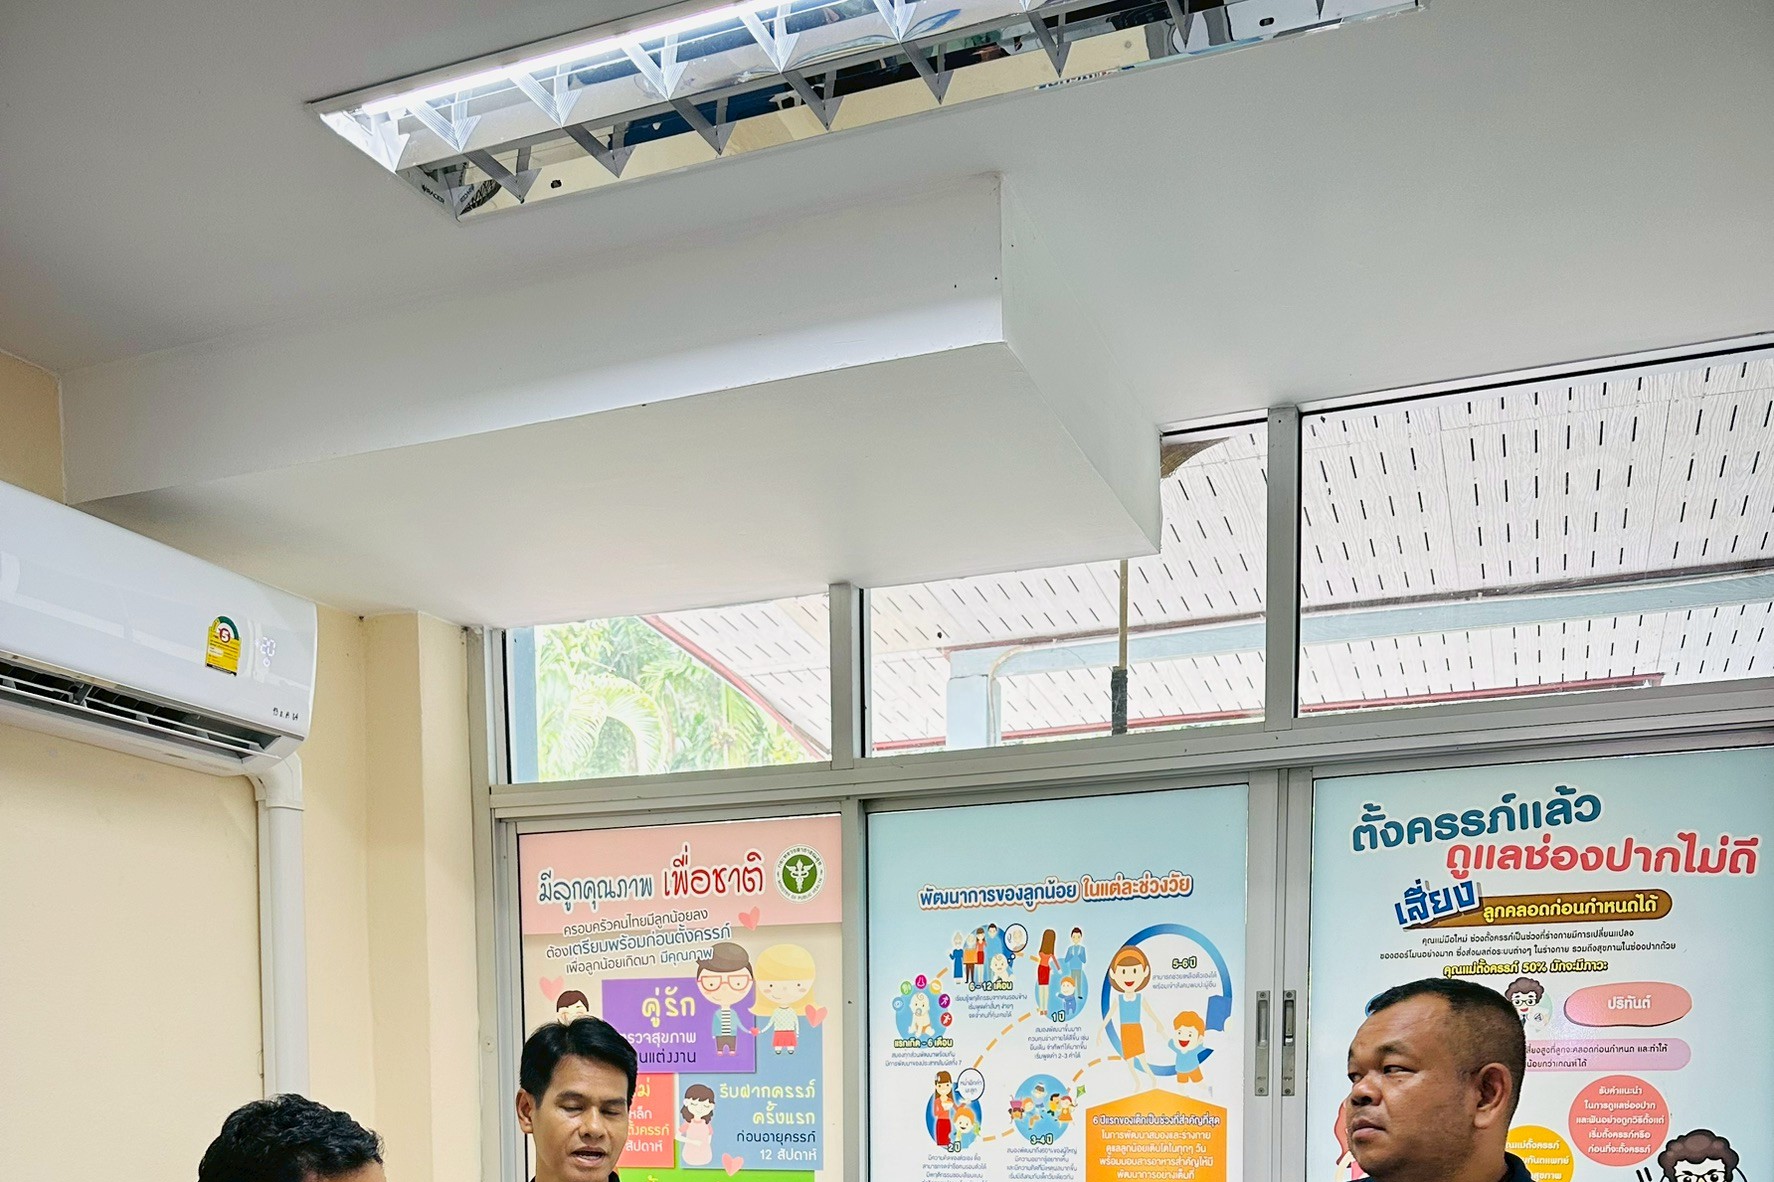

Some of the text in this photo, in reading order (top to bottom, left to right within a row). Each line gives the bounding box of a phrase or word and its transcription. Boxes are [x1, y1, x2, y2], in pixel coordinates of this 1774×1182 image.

[1351, 785, 1603, 852] ตั้งครรภ์แล้ว
[1446, 833, 1759, 880] ดูแลช่องปากไม่ดี
[539, 842, 764, 911] มีลูกคุณภาพ เพื่อชาติ
[919, 871, 1192, 908] พัฒนาการของลูกน้อย ในแต่ละช่วงวัย
[1395, 878, 1481, 928] เสี่ยง
[1484, 889, 1658, 924] ลูกคลอดก่อนกำหนดได้
[564, 909, 708, 936] ครอบครัวคนไทยมีลูกน้อยลง
[547, 922, 731, 959] ต้องเตรียมพร้อมก่อนตั้งครรภ์
[566, 948, 713, 975] เพื่อลูกน้อยเกิดมา มีคุณภาพ
[1172, 958, 1188, 969] 5-6
[1443, 958, 1608, 978] คุณแม่ตั้งครรภ์ 50% มักจะมีภาวะ
[969, 982, 975, 991] 6
[982, 981, 992, 991] 12
[993, 979, 1013, 991] เดือน
[642, 987, 695, 1028] คู่รัก
[1608, 995, 1652, 1010] ปริทันต์
[1051, 1011, 1057, 1022] 1
[927, 1039, 933, 1048] 6
[934, 1036, 953, 1047] เดือน
[639, 1050, 697, 1063] นแต่งงาน
[1526, 1043, 1634, 1057] สี่ยงสูงที่ลูกจะคลอดก่อนกำหนด
[1599, 1086, 1642, 1095] รับคำแนะนำ
[753, 1101, 815, 1125] ครั้งแรก
[1584, 1100, 1656, 1112] ในการดูแลช่องปาก
[1093, 1116, 1098, 1125] 6
[737, 1131, 816, 1145] ก่อนอายุครรภ์
[1030, 1135, 1045, 1145] 3-4
[1506, 1138, 1560, 1150] ณแม่ตั้งครรภ์
[760, 1148, 817, 1161] 12 สัปดาห์
